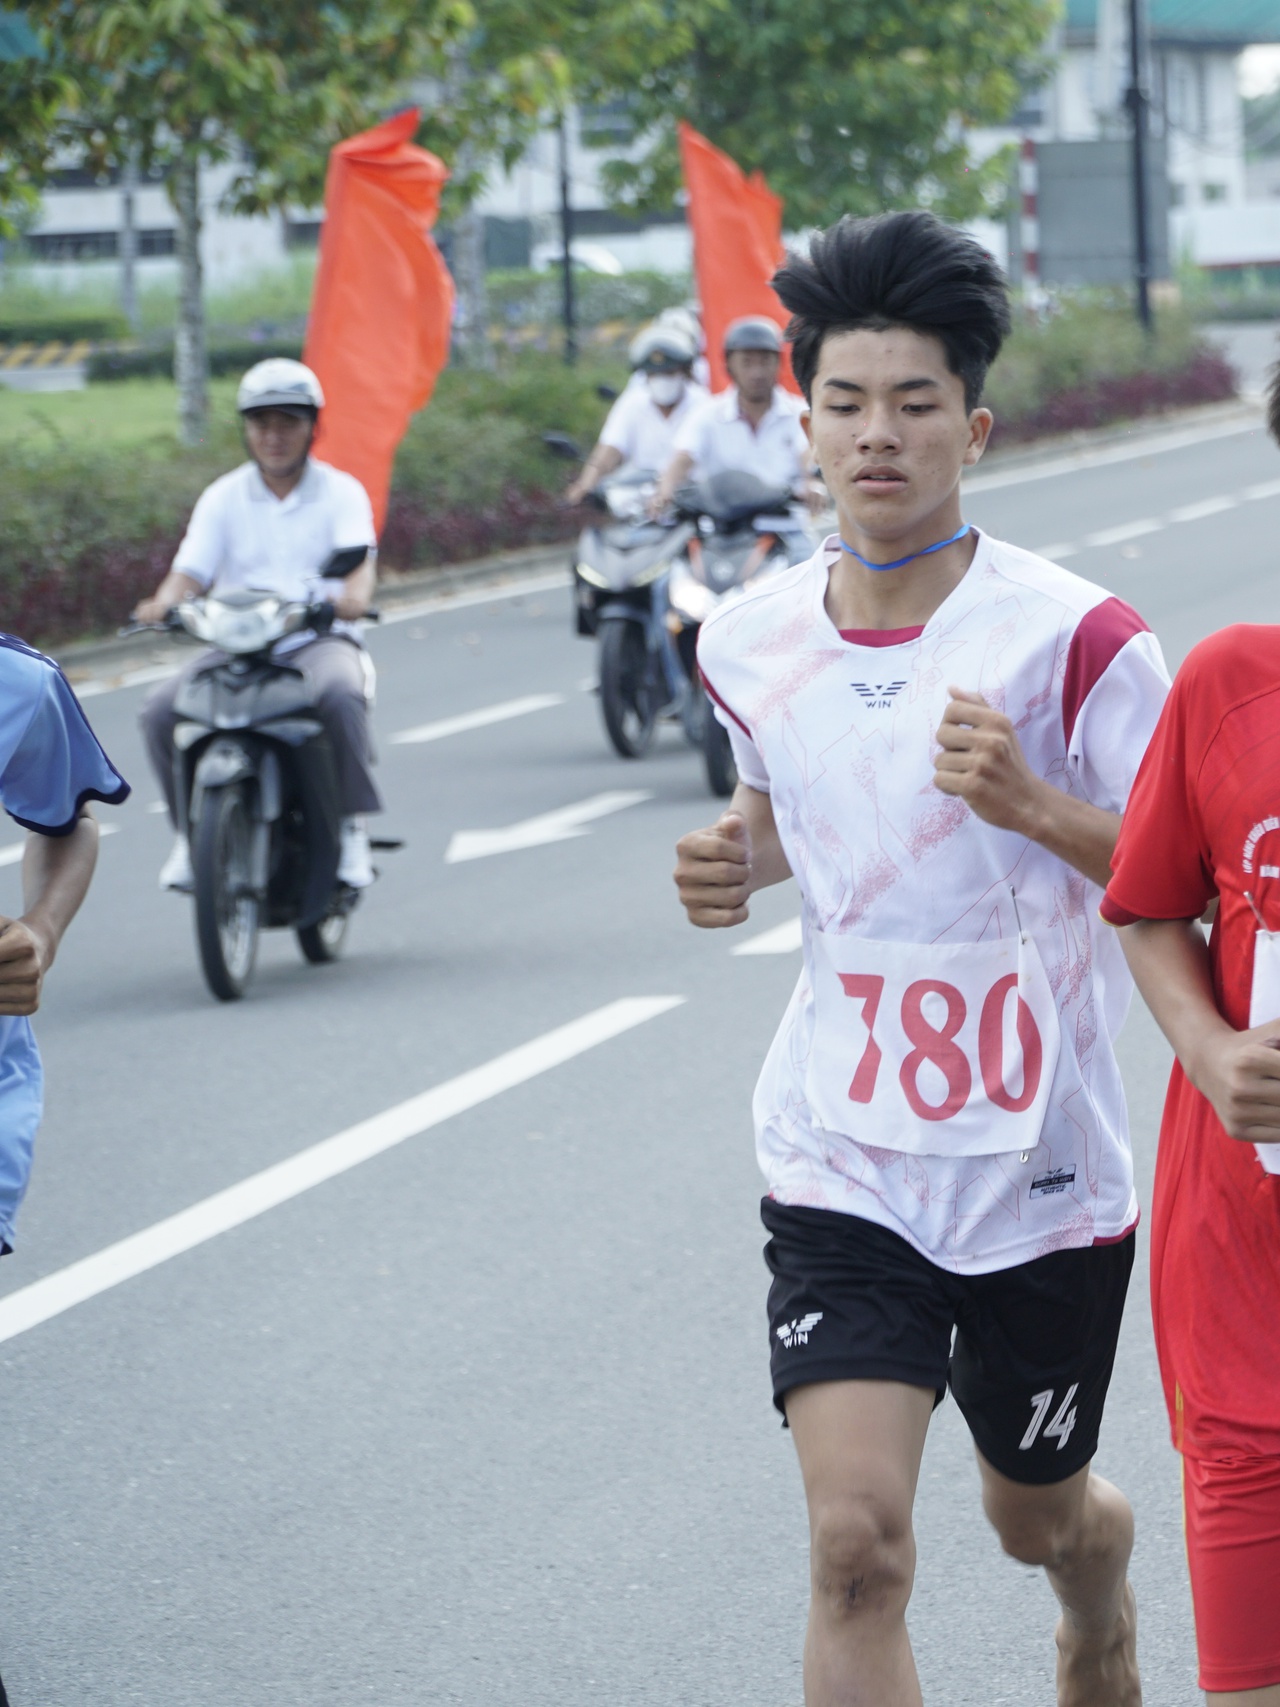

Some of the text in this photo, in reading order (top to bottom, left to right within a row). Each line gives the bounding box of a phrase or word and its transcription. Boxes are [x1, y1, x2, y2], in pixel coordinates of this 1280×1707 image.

[865, 699, 892, 709] WIN
[837, 972, 1043, 1122] 780
[783, 1330, 809, 1349] WIN
[1018, 1382, 1080, 1452] 14
